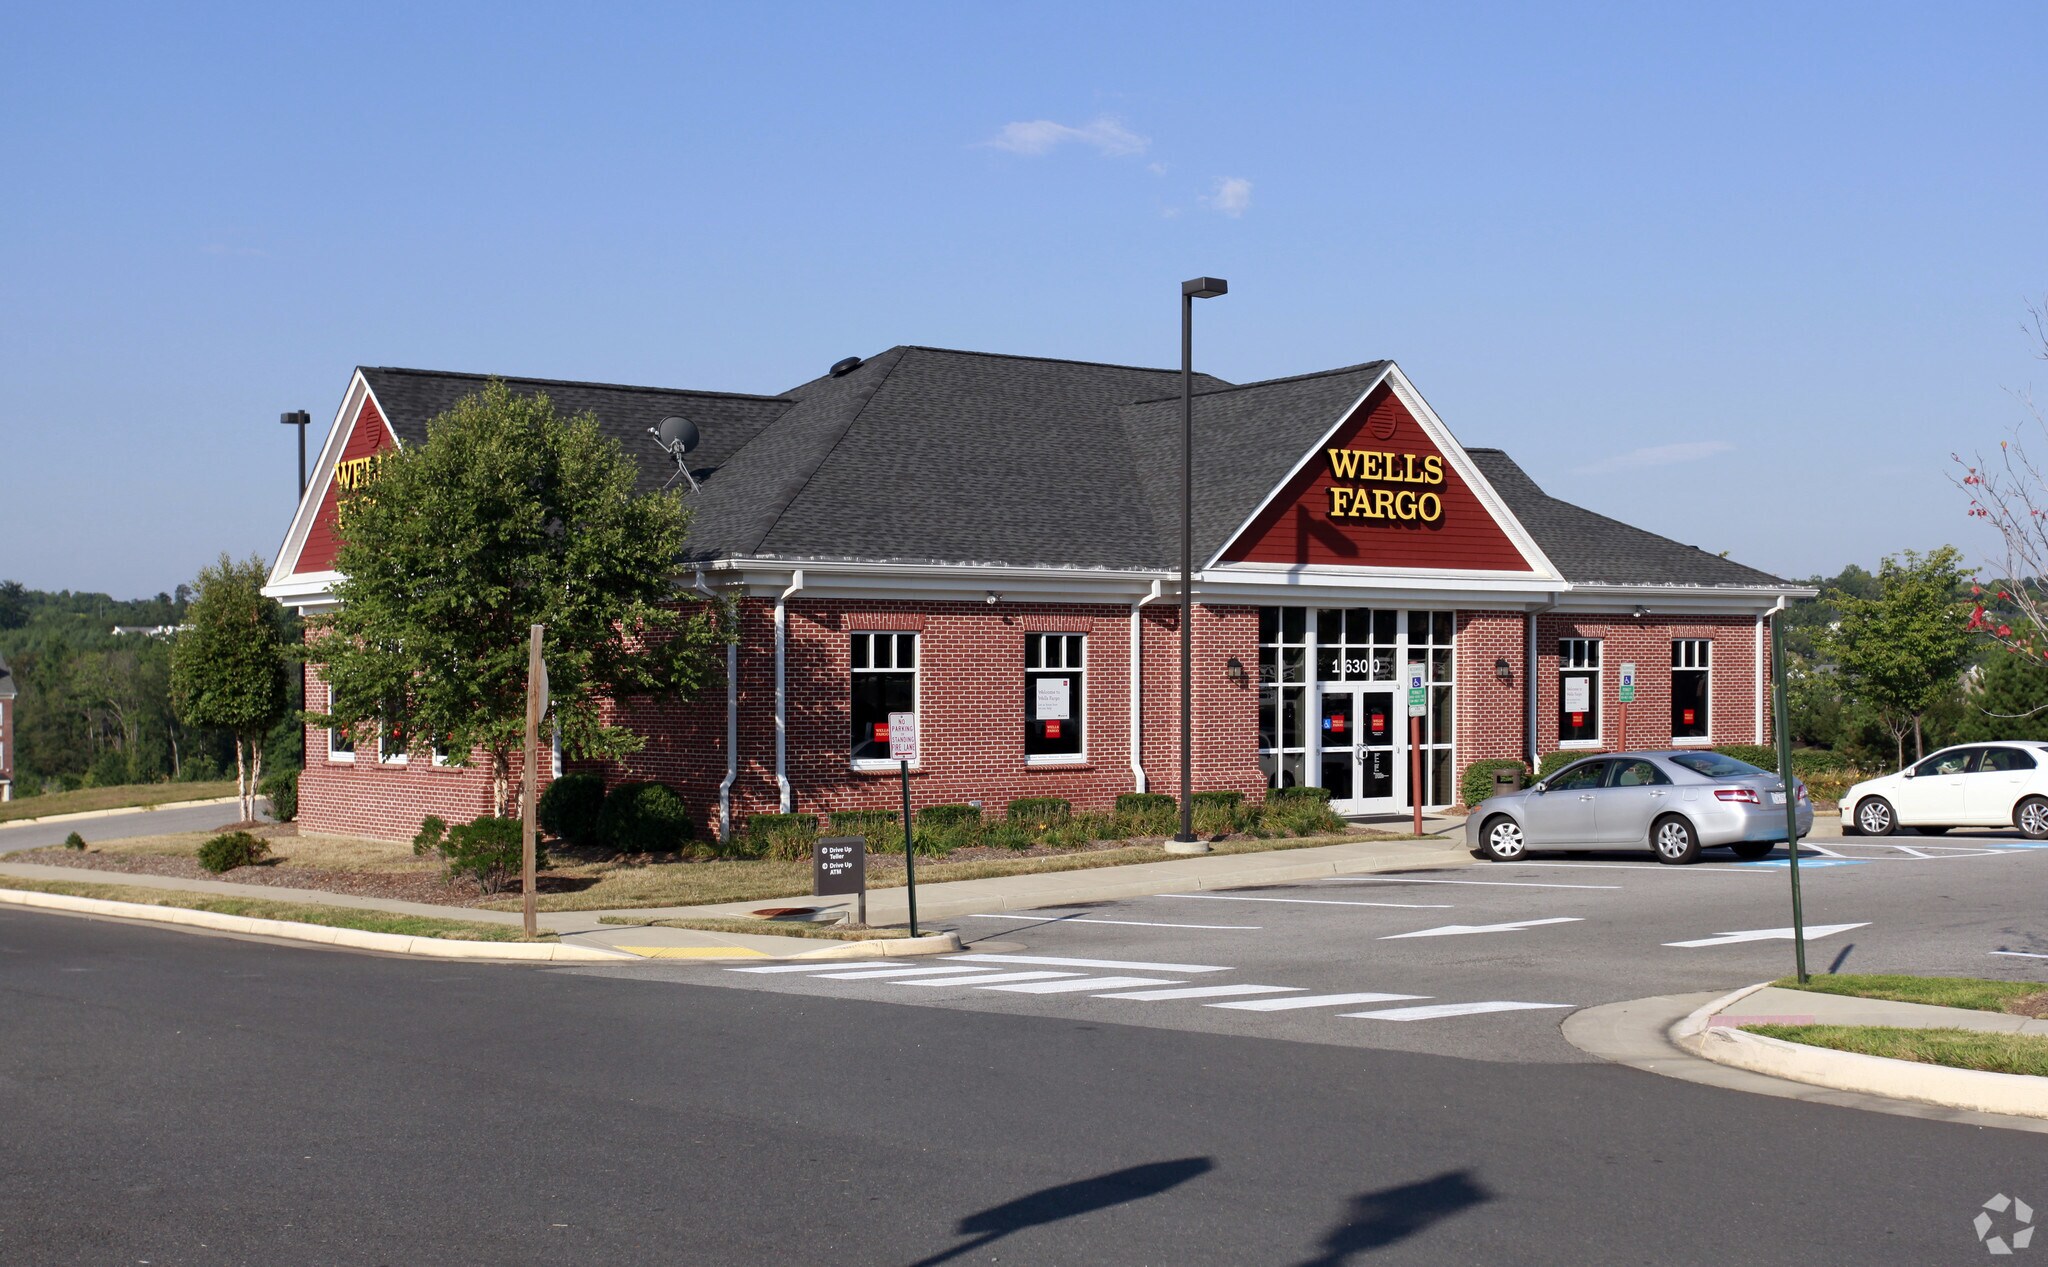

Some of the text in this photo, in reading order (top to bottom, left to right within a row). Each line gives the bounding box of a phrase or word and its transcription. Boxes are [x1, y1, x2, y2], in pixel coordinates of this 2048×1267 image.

[1328, 448, 1443, 485] WELLS
[1330, 487, 1442, 521] FARGO
[1332, 659, 1380, 673] 16300
[903, 743, 915, 751] LANE
